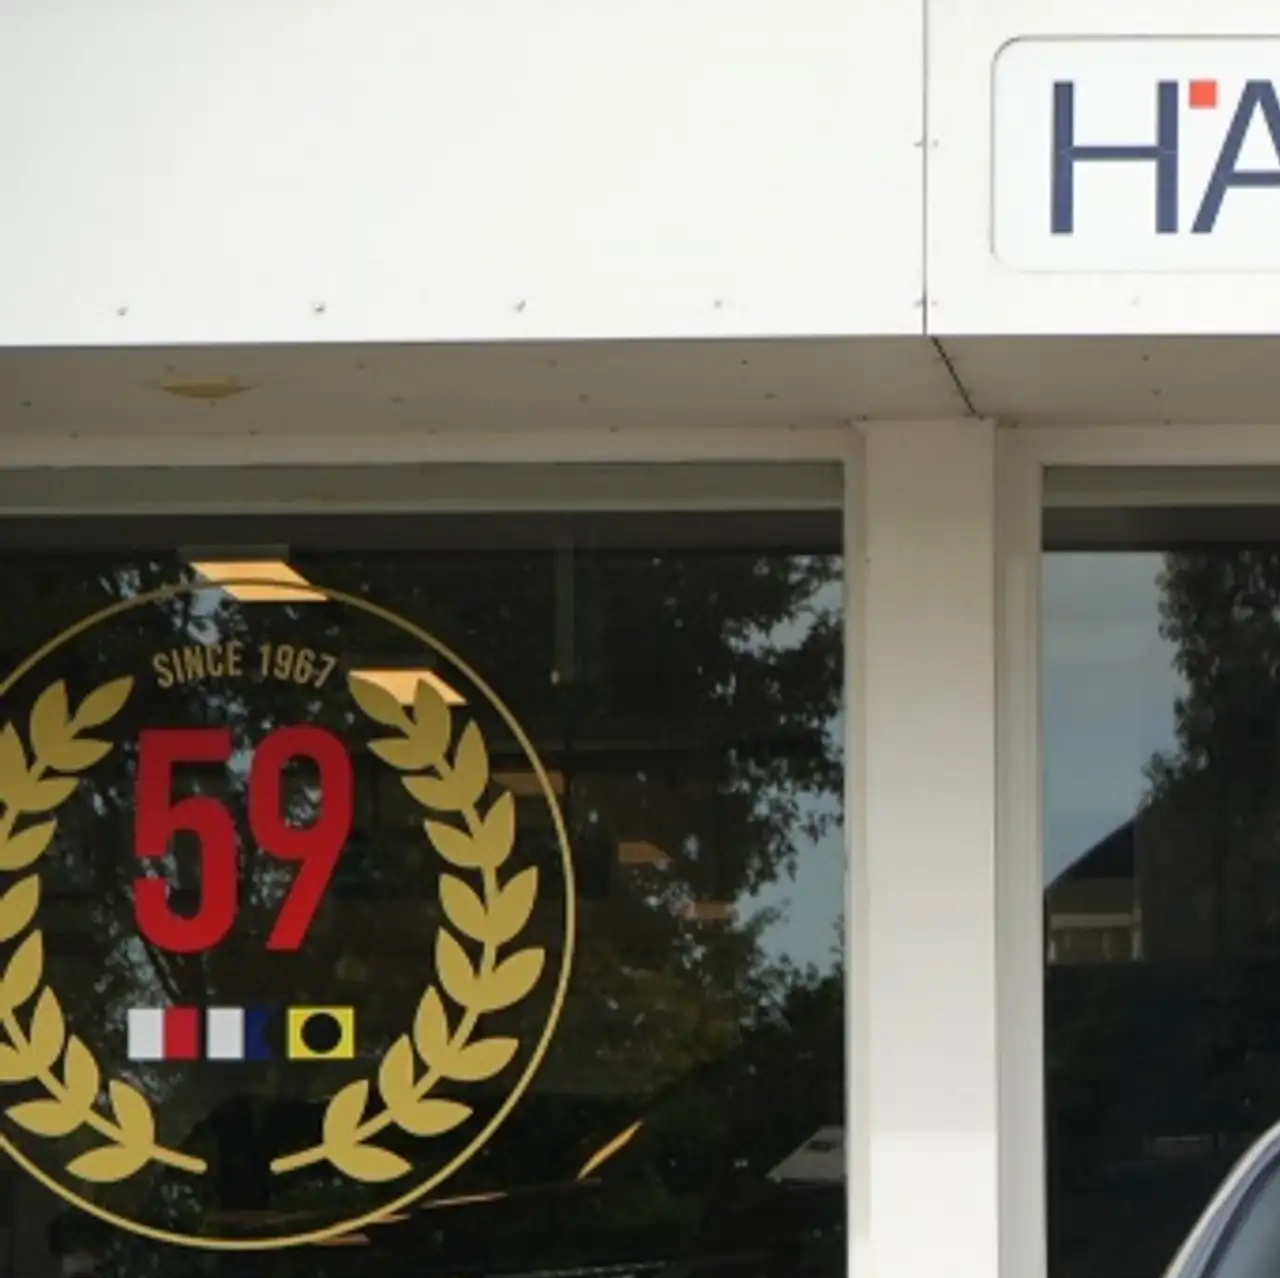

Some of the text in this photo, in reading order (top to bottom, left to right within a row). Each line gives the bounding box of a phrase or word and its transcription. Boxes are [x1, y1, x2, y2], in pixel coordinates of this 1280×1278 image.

[152, 640, 339, 689] SINCE 1967
[132, 724, 356, 954] 59
